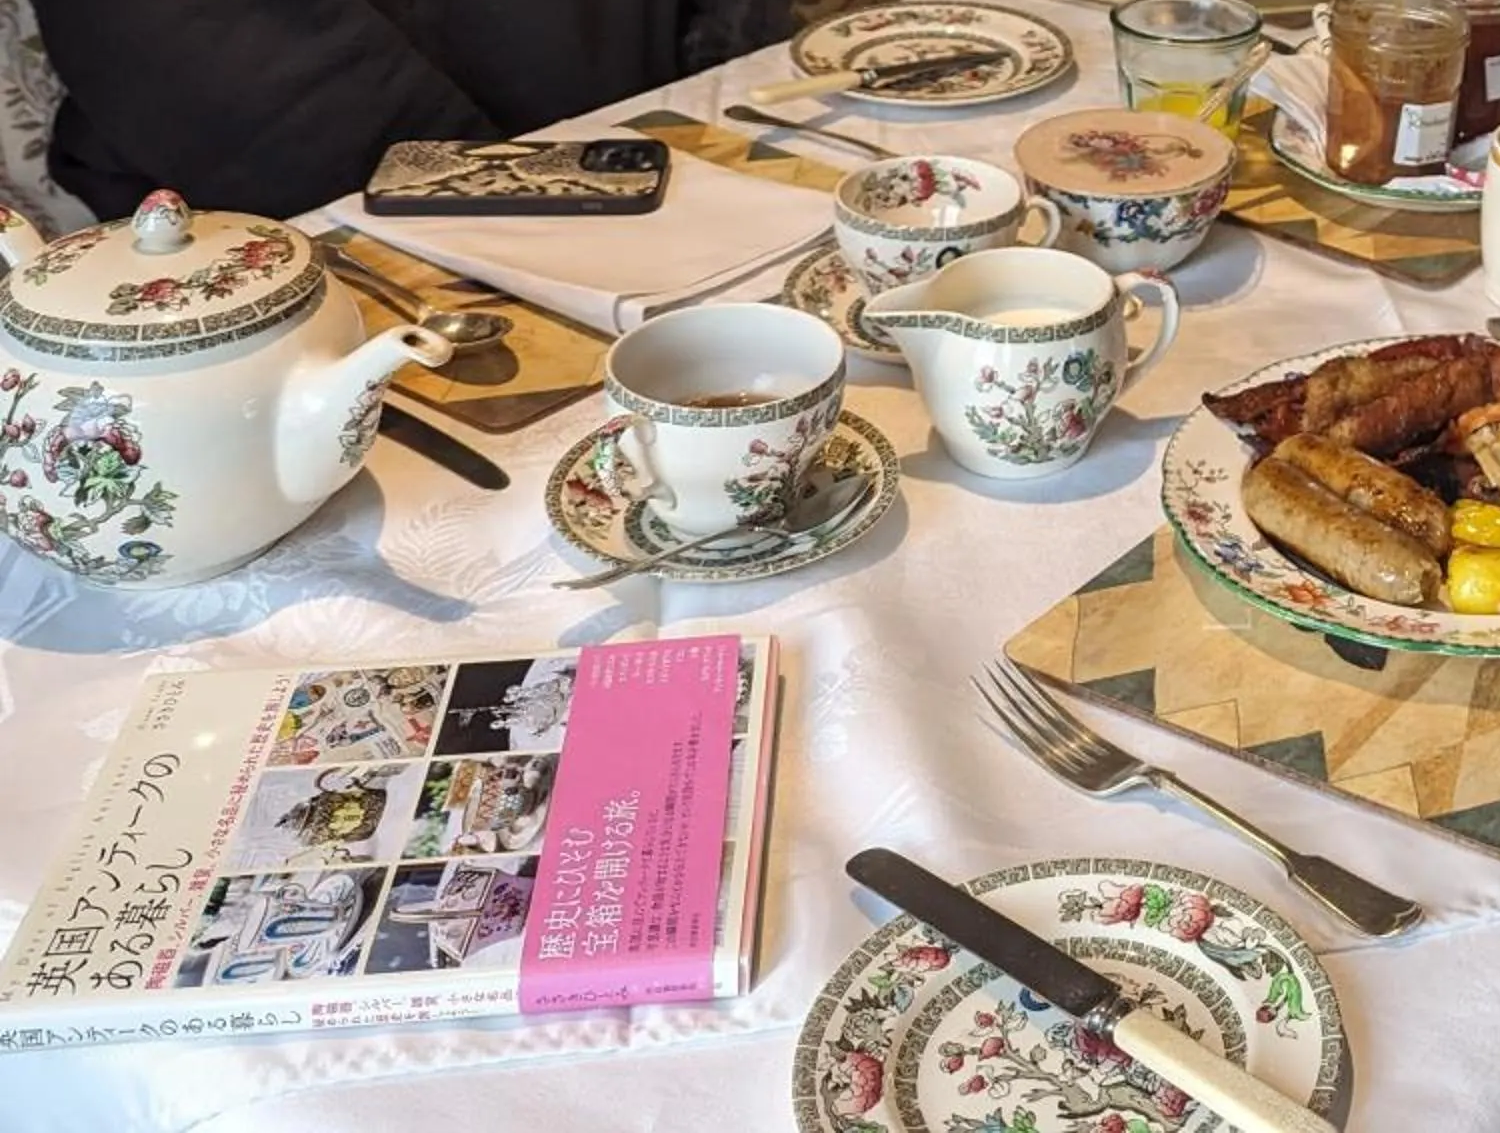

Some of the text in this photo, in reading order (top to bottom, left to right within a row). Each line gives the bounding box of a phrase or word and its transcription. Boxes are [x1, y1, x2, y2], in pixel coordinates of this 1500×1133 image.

[26, 753, 182, 996] 英国アンティークの
[89, 848, 193, 990] ある暮らし
[538, 825, 596, 959] 歴史にひそむ
[579, 789, 642, 956] 宝箱を開ける旅。
